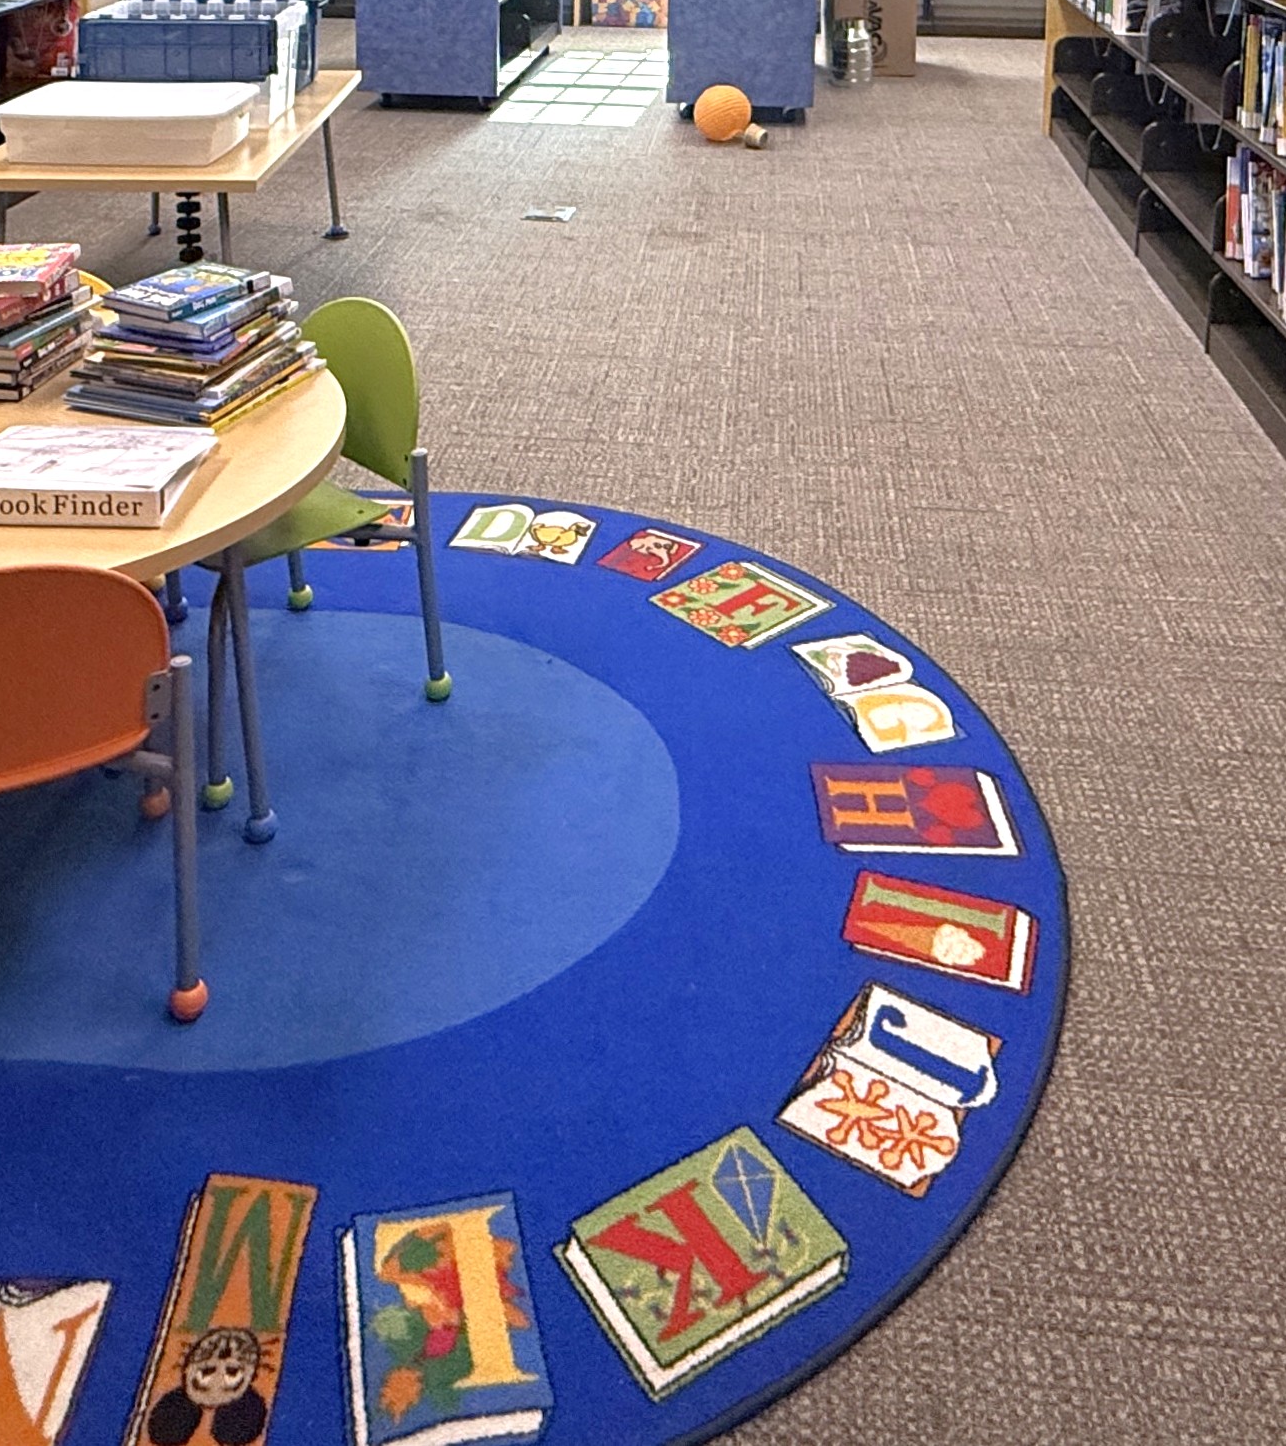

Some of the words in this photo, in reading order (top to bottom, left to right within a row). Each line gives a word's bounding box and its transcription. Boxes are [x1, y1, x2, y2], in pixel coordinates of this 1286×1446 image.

[54, 494, 143, 516] Finder
[457, 509, 527, 543] D
[715, 580, 800, 622] F
[854, 694, 954, 744] G
[824, 776, 916, 830] H
[868, 1003, 991, 1107] J
[587, 1178, 773, 1344] K
